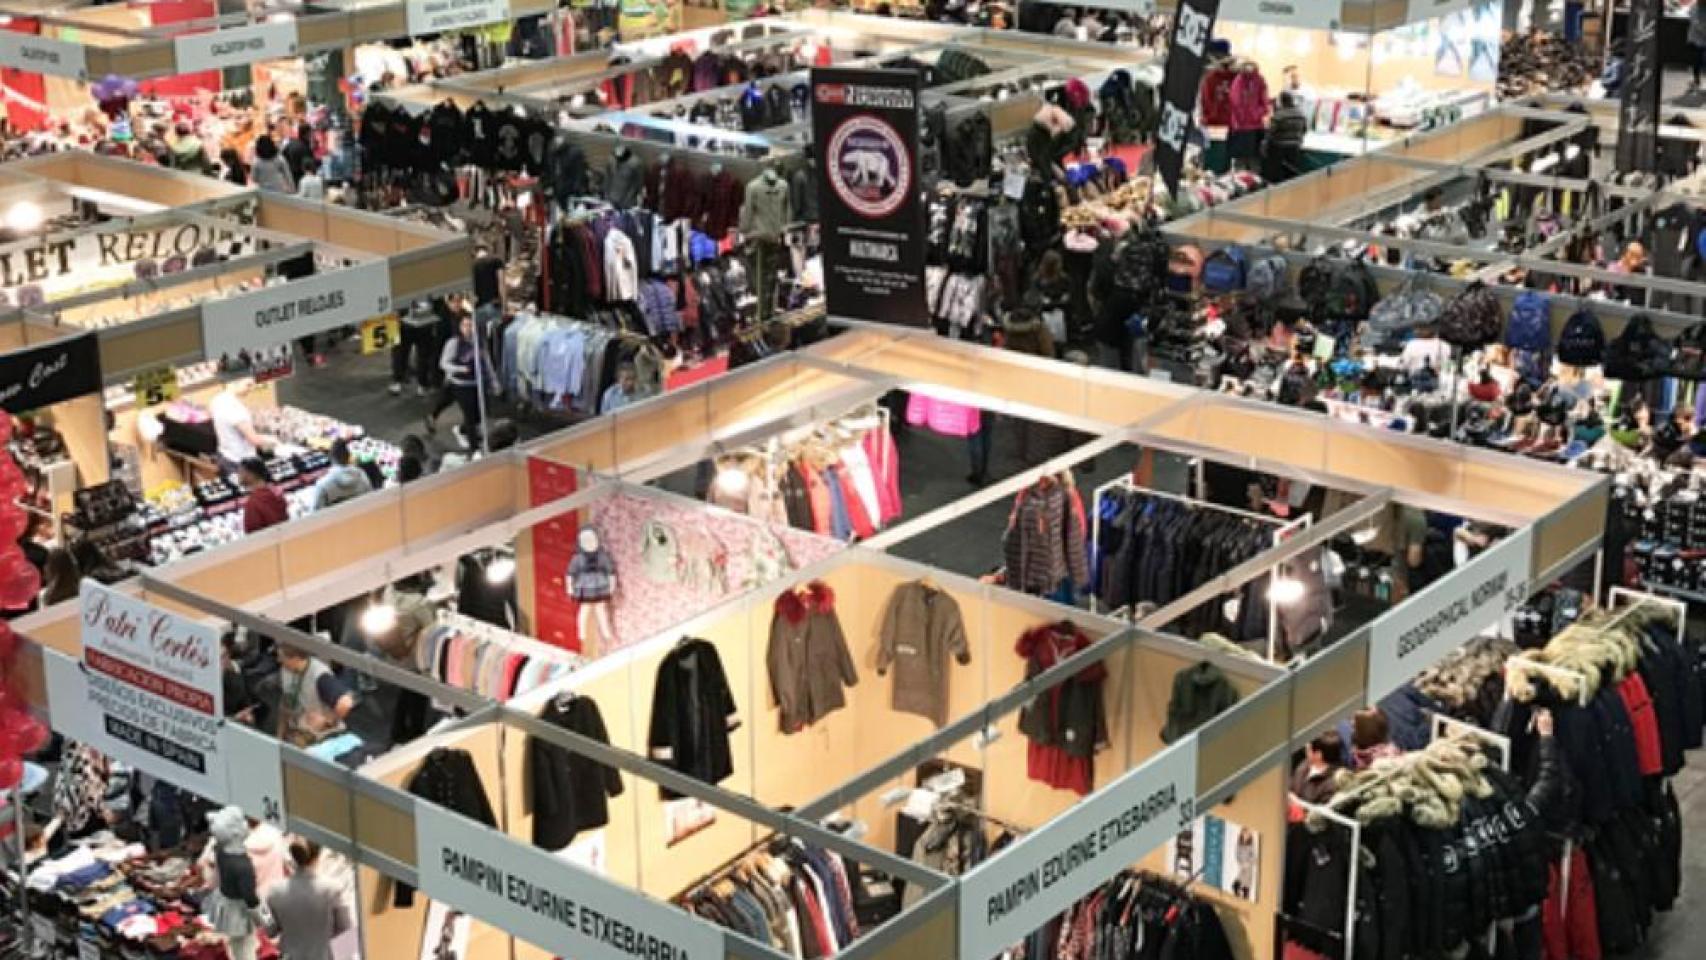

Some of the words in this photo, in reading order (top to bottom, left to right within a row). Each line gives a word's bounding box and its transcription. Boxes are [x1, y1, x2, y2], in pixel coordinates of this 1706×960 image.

[255, 302, 295, 328] OUTLET
[1397, 598, 1469, 658] GEOGRAPHICAL
[262, 796, 281, 820] 34
[1178, 797, 1194, 827] 33
[987, 865, 1040, 926] PAMPIN
[1042, 829, 1097, 889] EDURNE
[1099, 783, 1176, 851] ETXEBARRIA
[442, 847, 504, 897] PAMPIN
[507, 874, 577, 930] EDURNE
